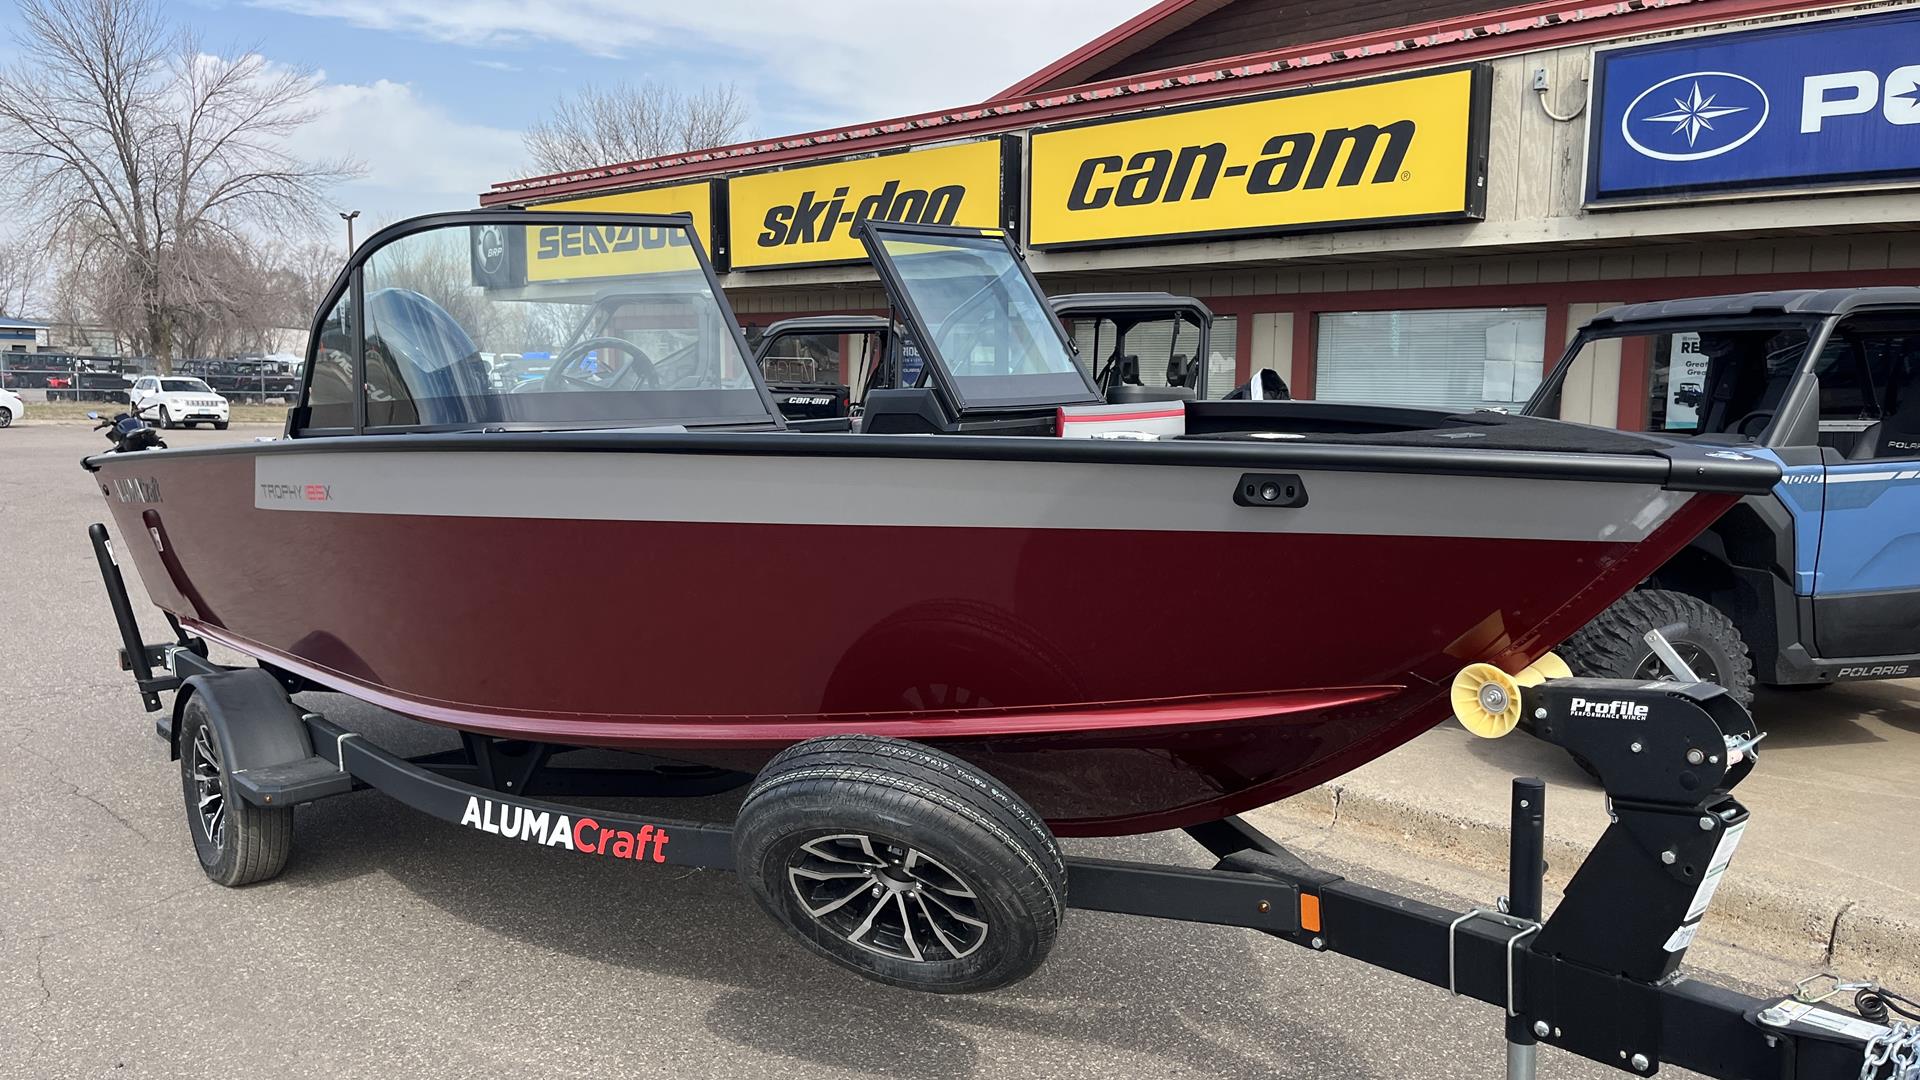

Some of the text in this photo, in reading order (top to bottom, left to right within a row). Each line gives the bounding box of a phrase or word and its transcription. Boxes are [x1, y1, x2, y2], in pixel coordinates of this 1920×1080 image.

[1067, 119, 1416, 211] can-am
[487, 247, 503, 258] BRP
[788, 397, 830, 405] can-am
[260, 484, 302, 499] TROPHY
[1837, 665, 1909, 678] POLARIS
[1570, 697, 1649, 717] Profile
[1570, 710, 1620, 719] PERFORMANCE
[460, 796, 670, 863] ALUMACraft
